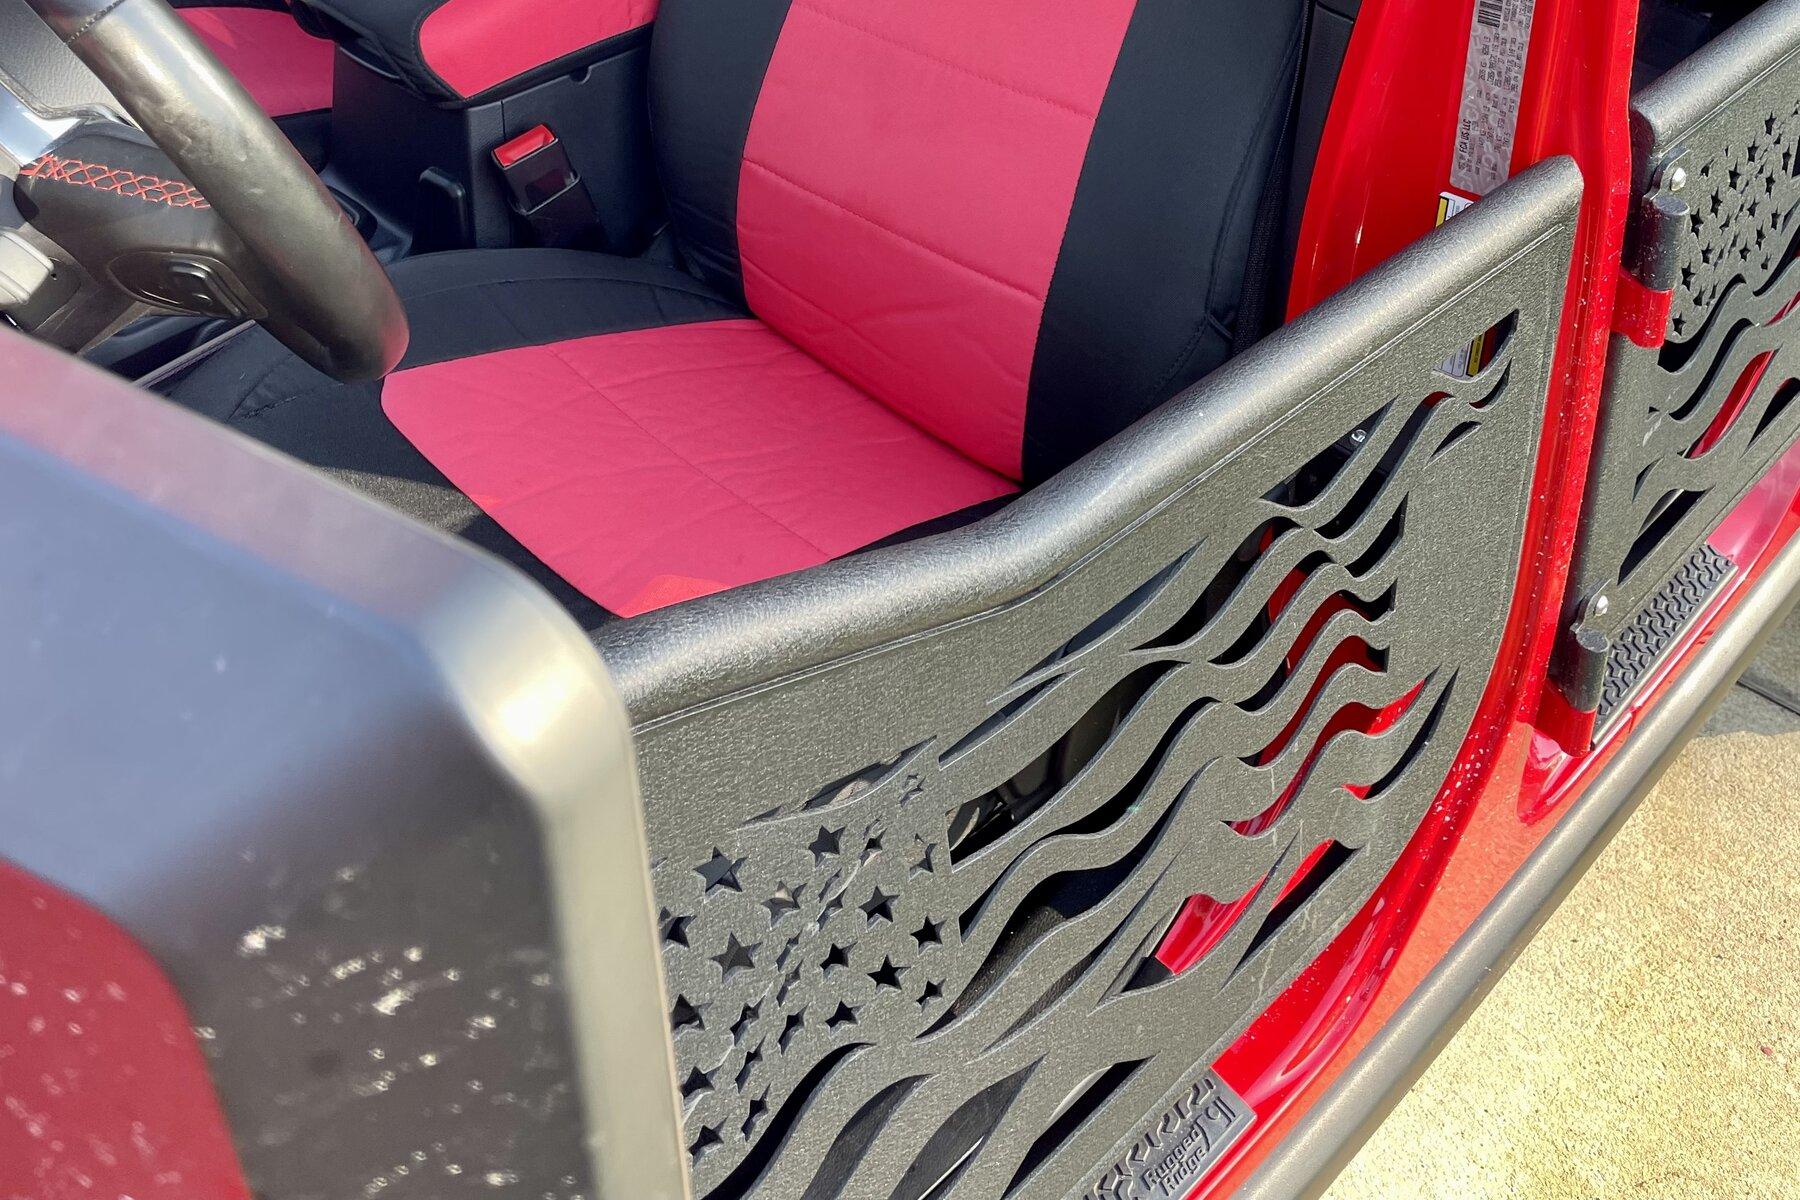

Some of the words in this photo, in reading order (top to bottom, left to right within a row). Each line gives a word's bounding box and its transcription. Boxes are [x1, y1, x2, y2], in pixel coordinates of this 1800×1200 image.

[1462, 119, 1472, 131] LLC
[1460, 130, 1470, 141] US
[1458, 140, 1469, 154] FCA
[1140, 1126, 1202, 1190] Rugged
[1158, 1147, 1206, 1197] Ridge
